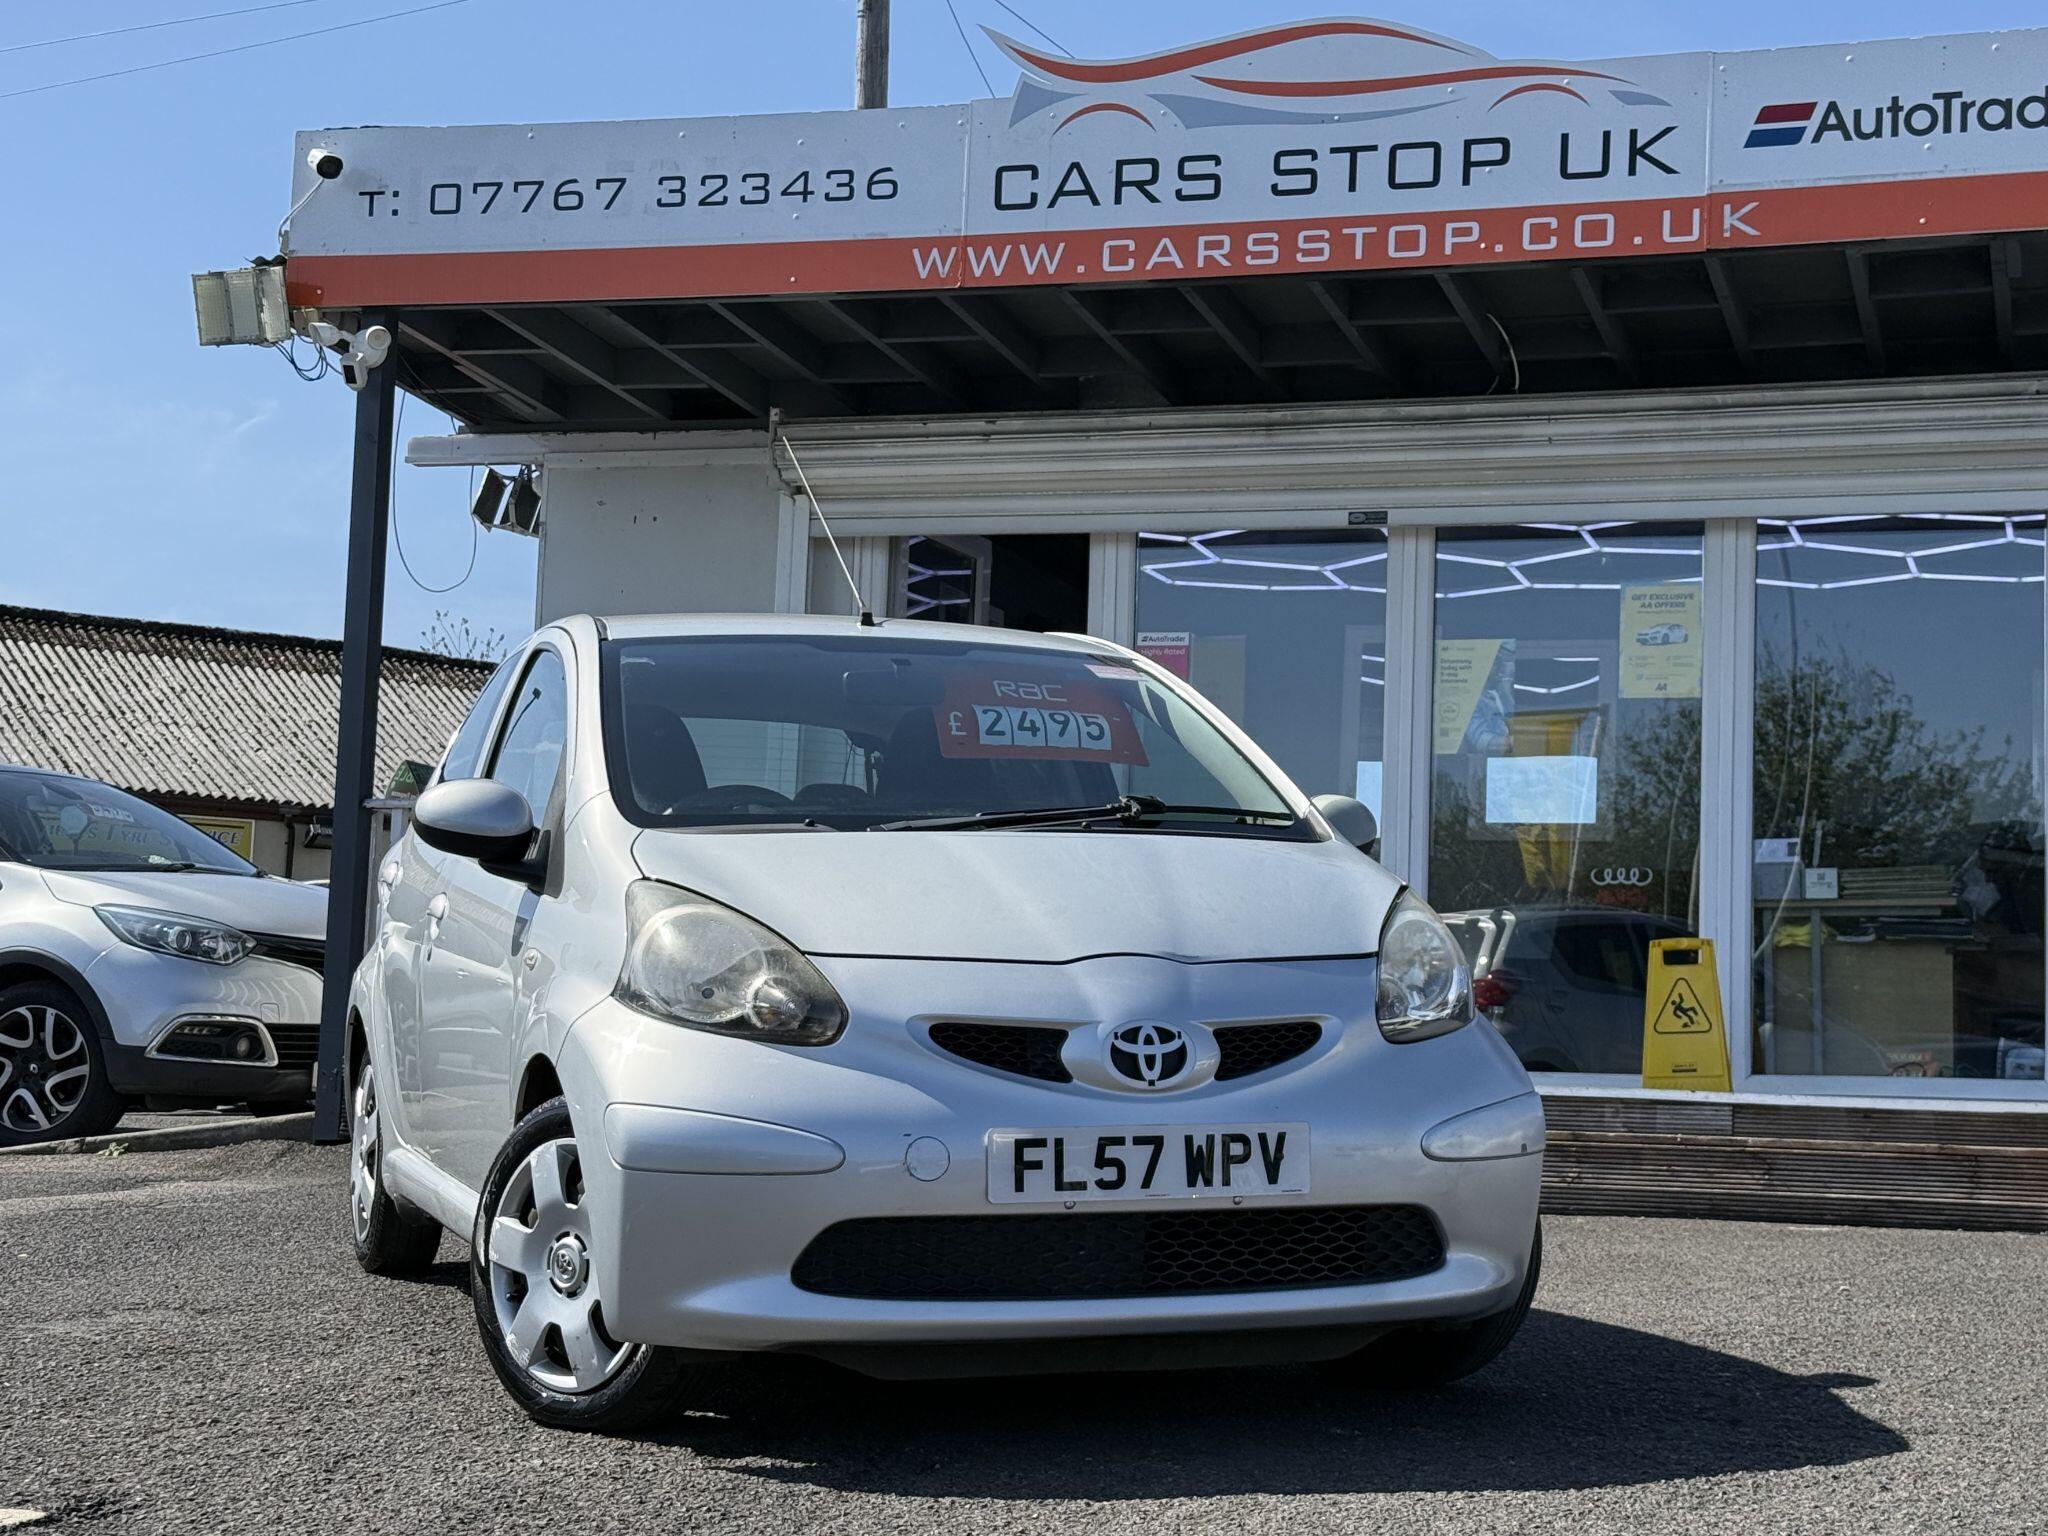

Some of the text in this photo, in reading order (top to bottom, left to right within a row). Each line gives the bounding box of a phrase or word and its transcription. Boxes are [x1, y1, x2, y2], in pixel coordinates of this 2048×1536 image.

[358, 166, 899, 218] T: 07767 323436
[994, 125, 1681, 212] CARS STOP UK
[912, 202, 1762, 280] WWW.CARSSTOP.CO.UK
[1148, 635, 1186, 643] AutoTrader
[981, 708, 1106, 741] 2495
[1013, 1131, 1287, 1193] FL57 WPV
